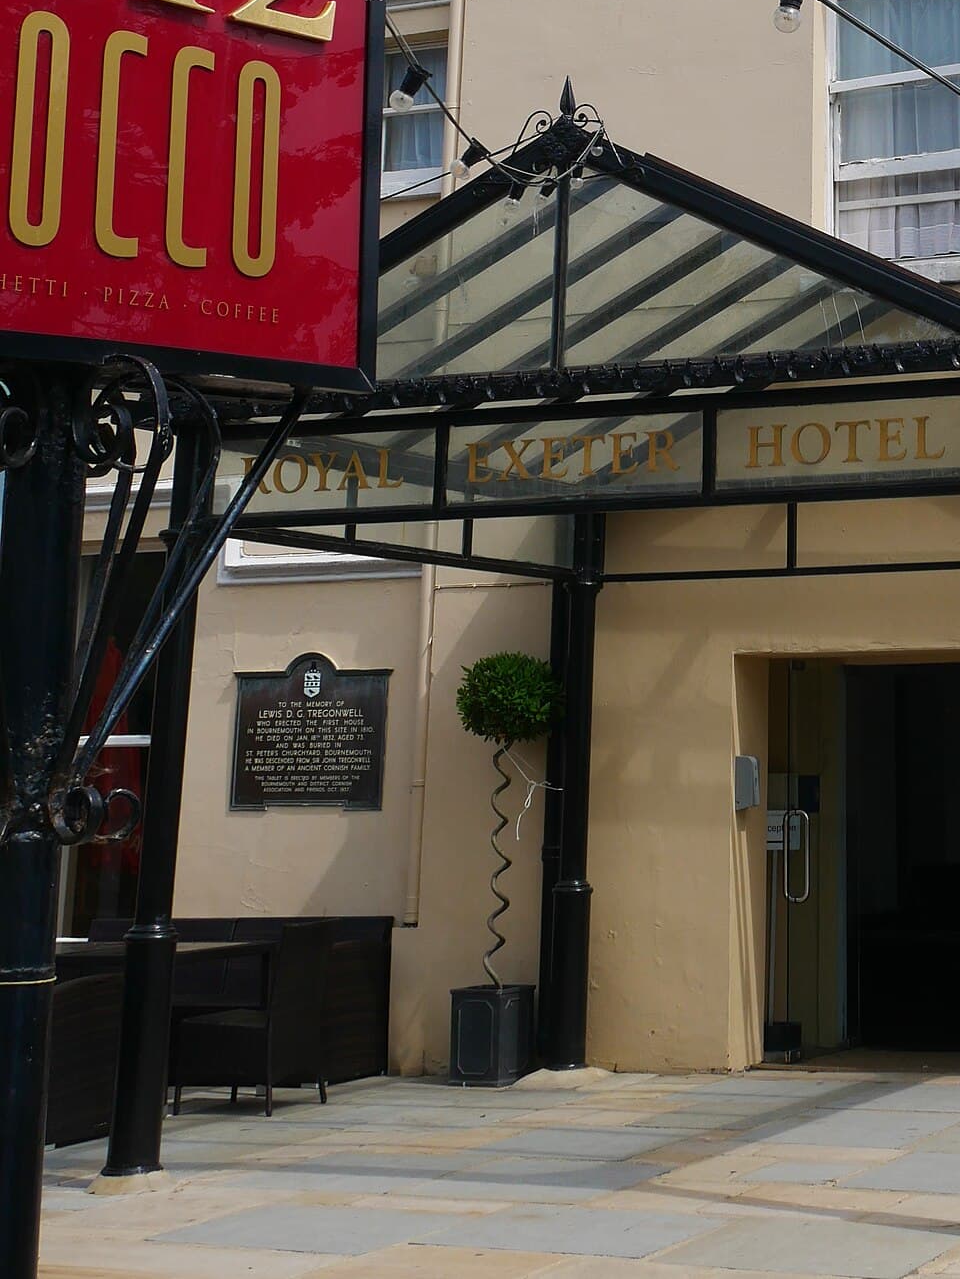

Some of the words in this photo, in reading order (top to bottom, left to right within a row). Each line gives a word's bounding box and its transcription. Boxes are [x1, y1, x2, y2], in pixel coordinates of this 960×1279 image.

[9, 10, 281, 277] OCCO
[103, 286, 170, 310] PIZZA
[200, 299, 280, 324] COFFEE
[466, 430, 680, 484] EXETER
[746, 415, 946, 469] HOTEL
[259, 710, 282, 719] LEWIS
[308, 709, 363, 718] TREGONWELL
